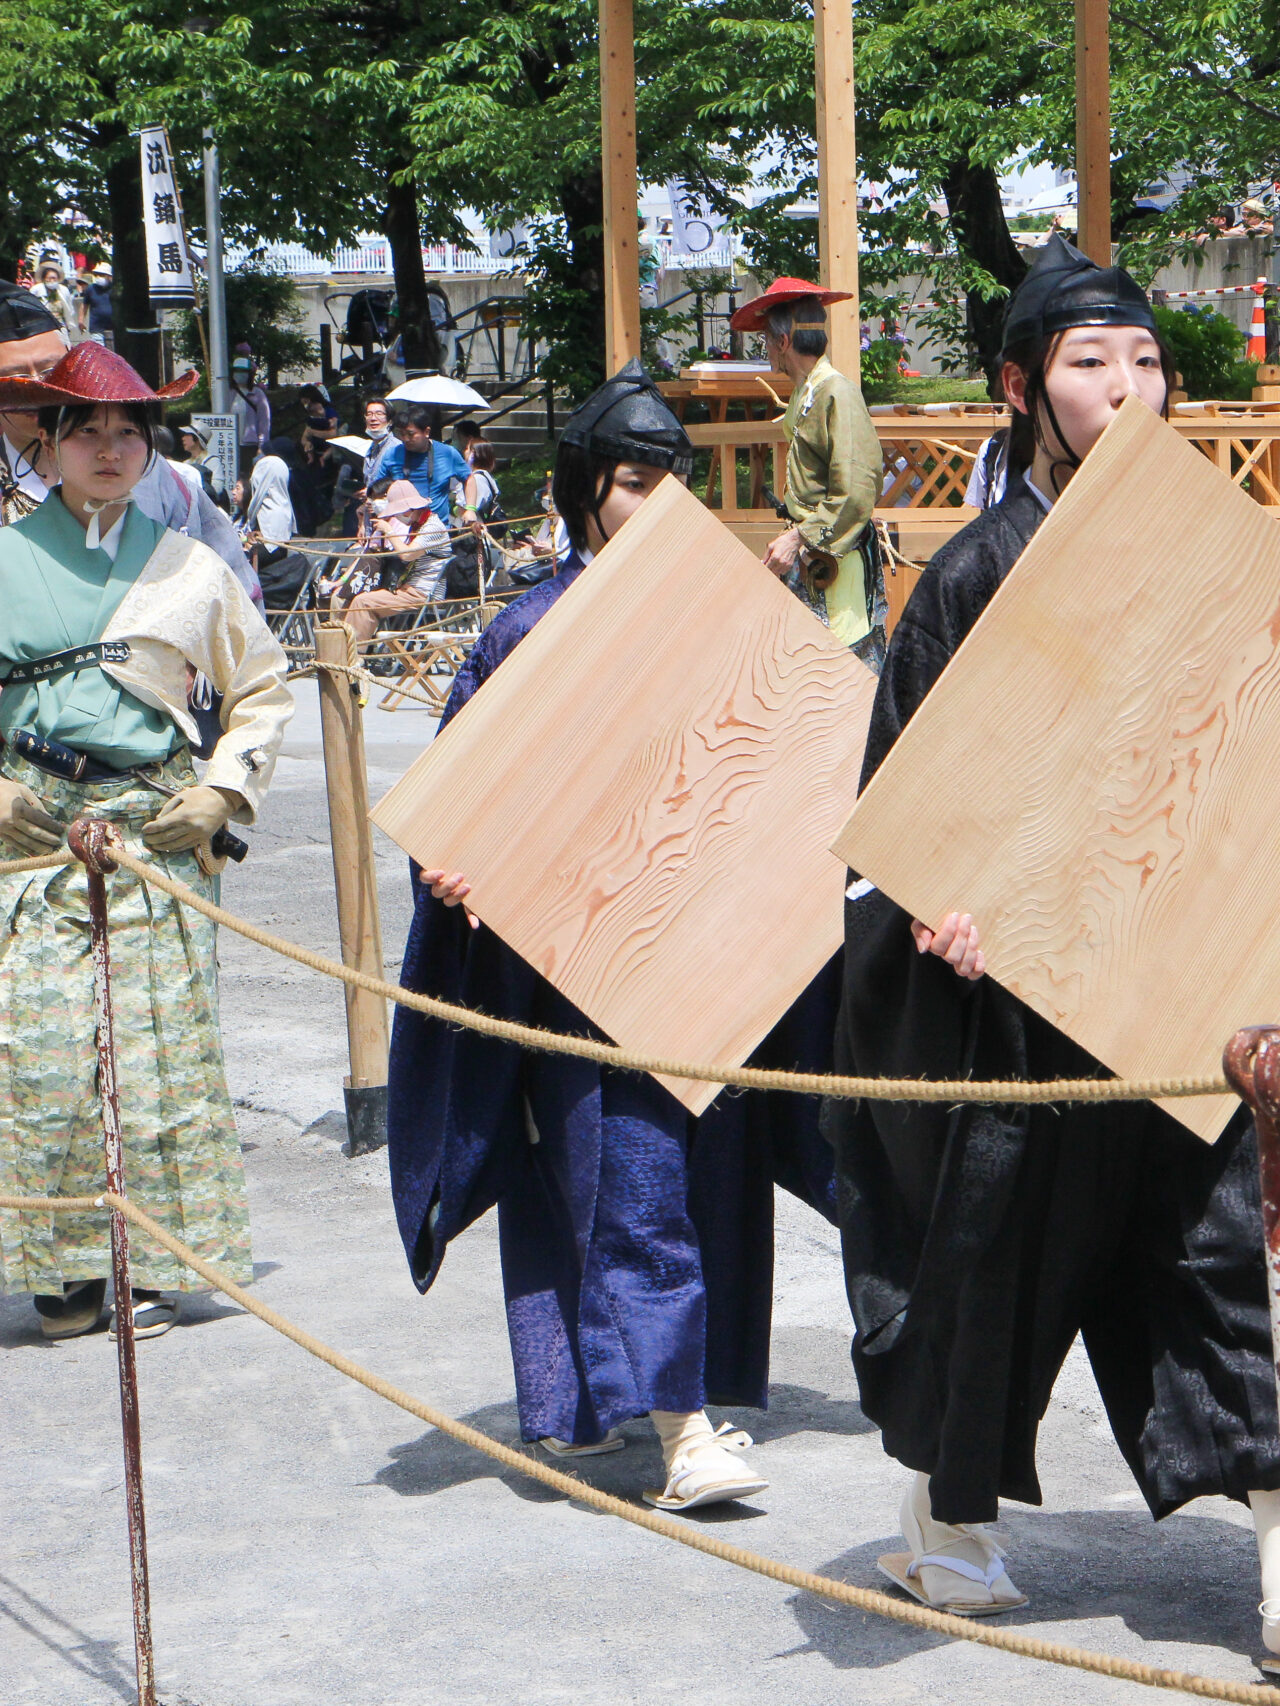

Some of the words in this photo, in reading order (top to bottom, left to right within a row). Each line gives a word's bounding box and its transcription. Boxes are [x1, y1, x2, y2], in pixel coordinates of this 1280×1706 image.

[147, 140, 183, 274] 流鏑馬
[194, 417, 234, 428] 投棄禁止
